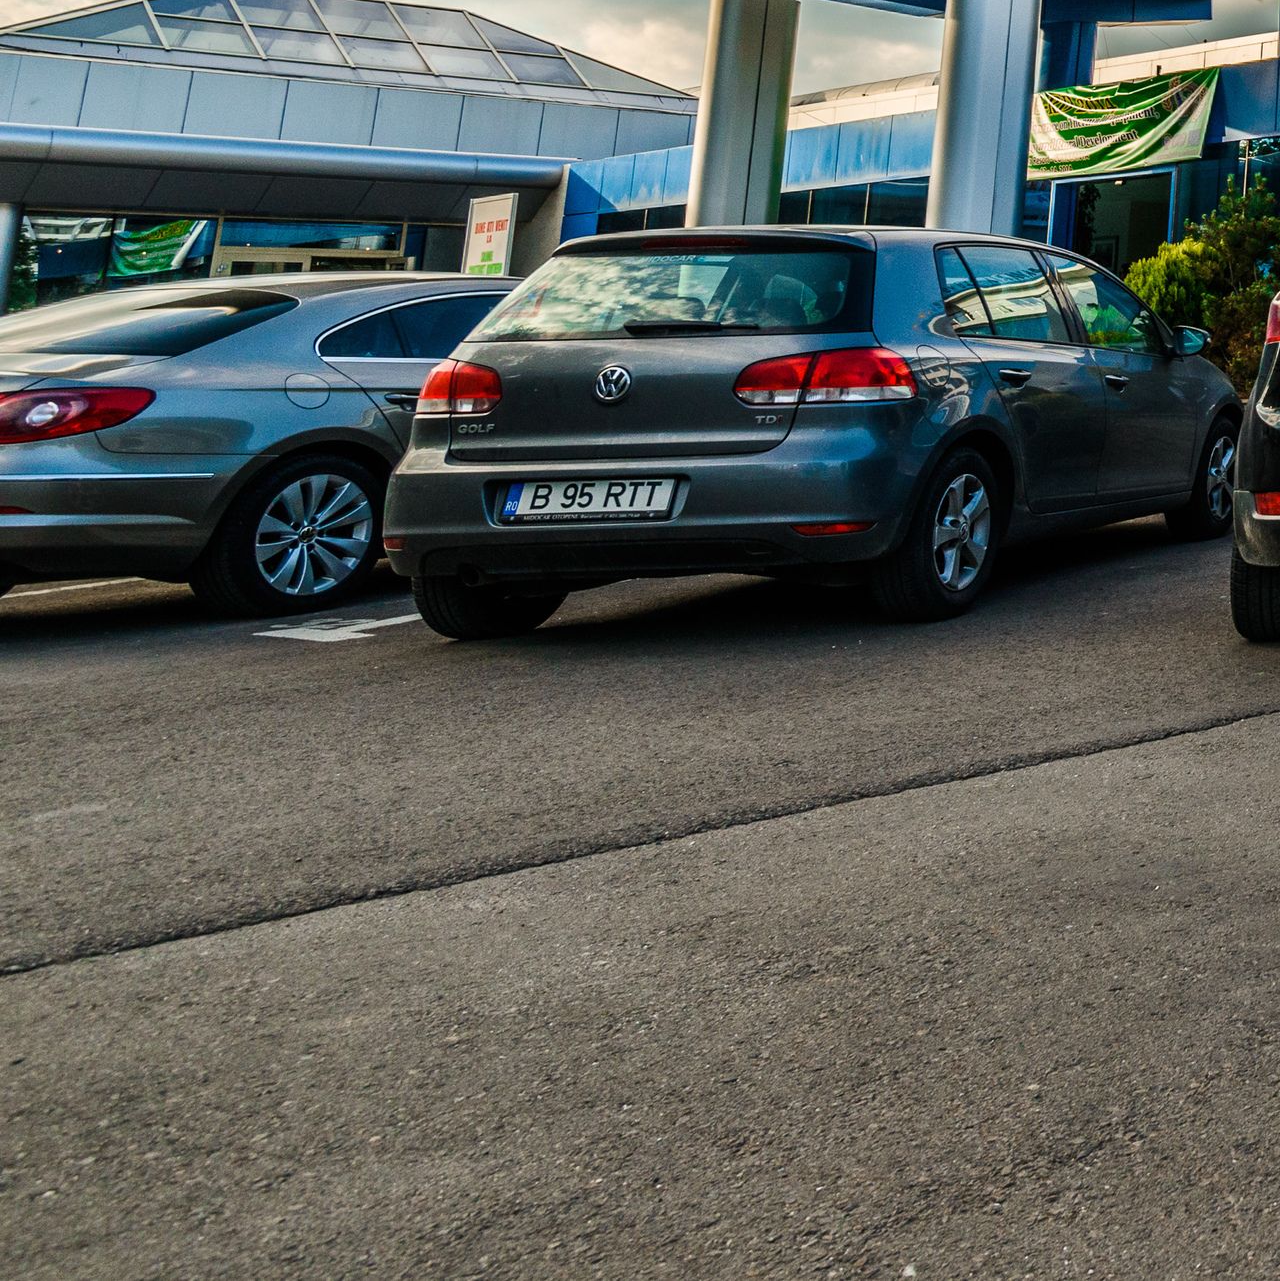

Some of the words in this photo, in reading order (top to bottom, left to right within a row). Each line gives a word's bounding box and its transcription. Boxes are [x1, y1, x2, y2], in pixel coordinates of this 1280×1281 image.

[457, 423, 495, 434] GOLF
[530, 484, 553, 510] B
[560, 483, 596, 509] 95
[603, 481, 663, 508] RTT
[505, 501, 518, 511] RO
